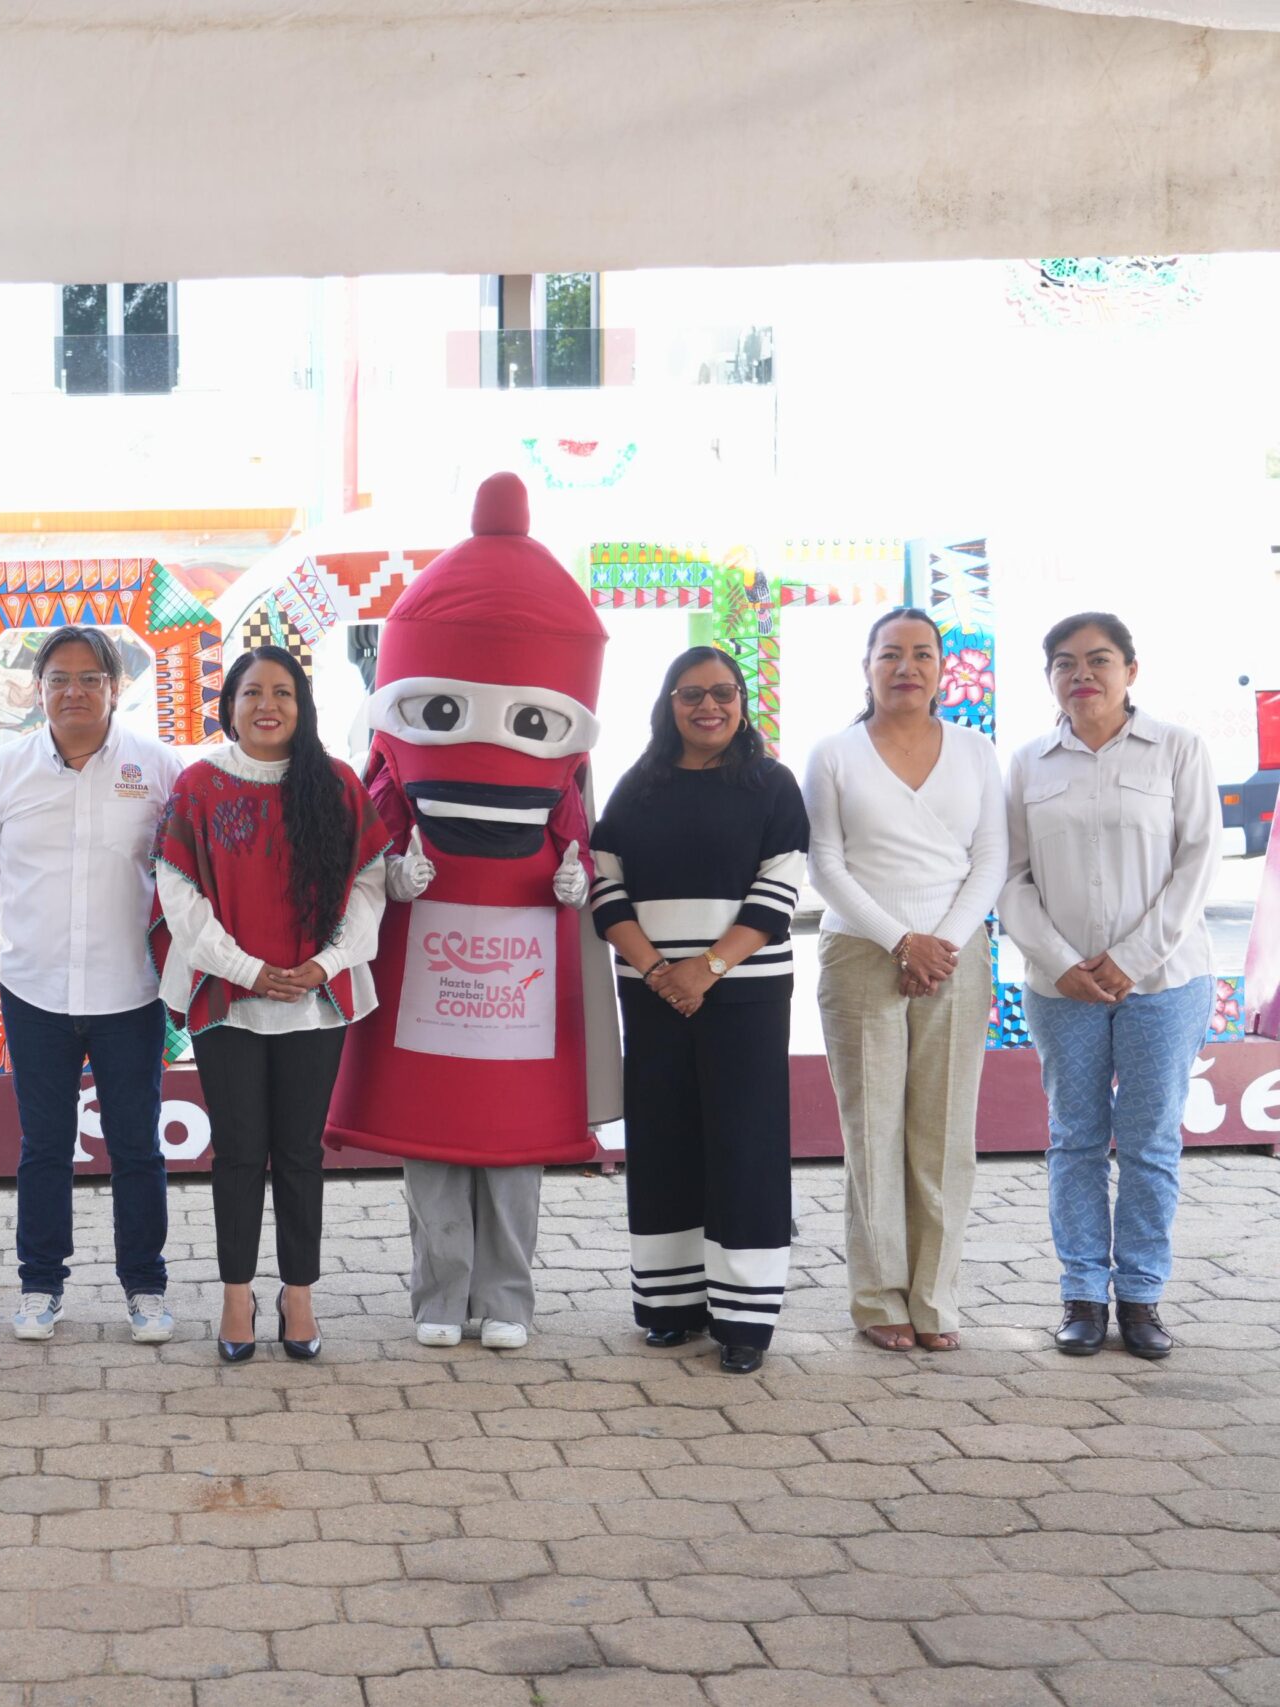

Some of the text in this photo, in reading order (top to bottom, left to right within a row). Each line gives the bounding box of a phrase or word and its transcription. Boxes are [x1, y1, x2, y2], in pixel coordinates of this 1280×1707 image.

[440, 977, 485, 990] Hazte la
[486, 985, 525, 1002] USA
